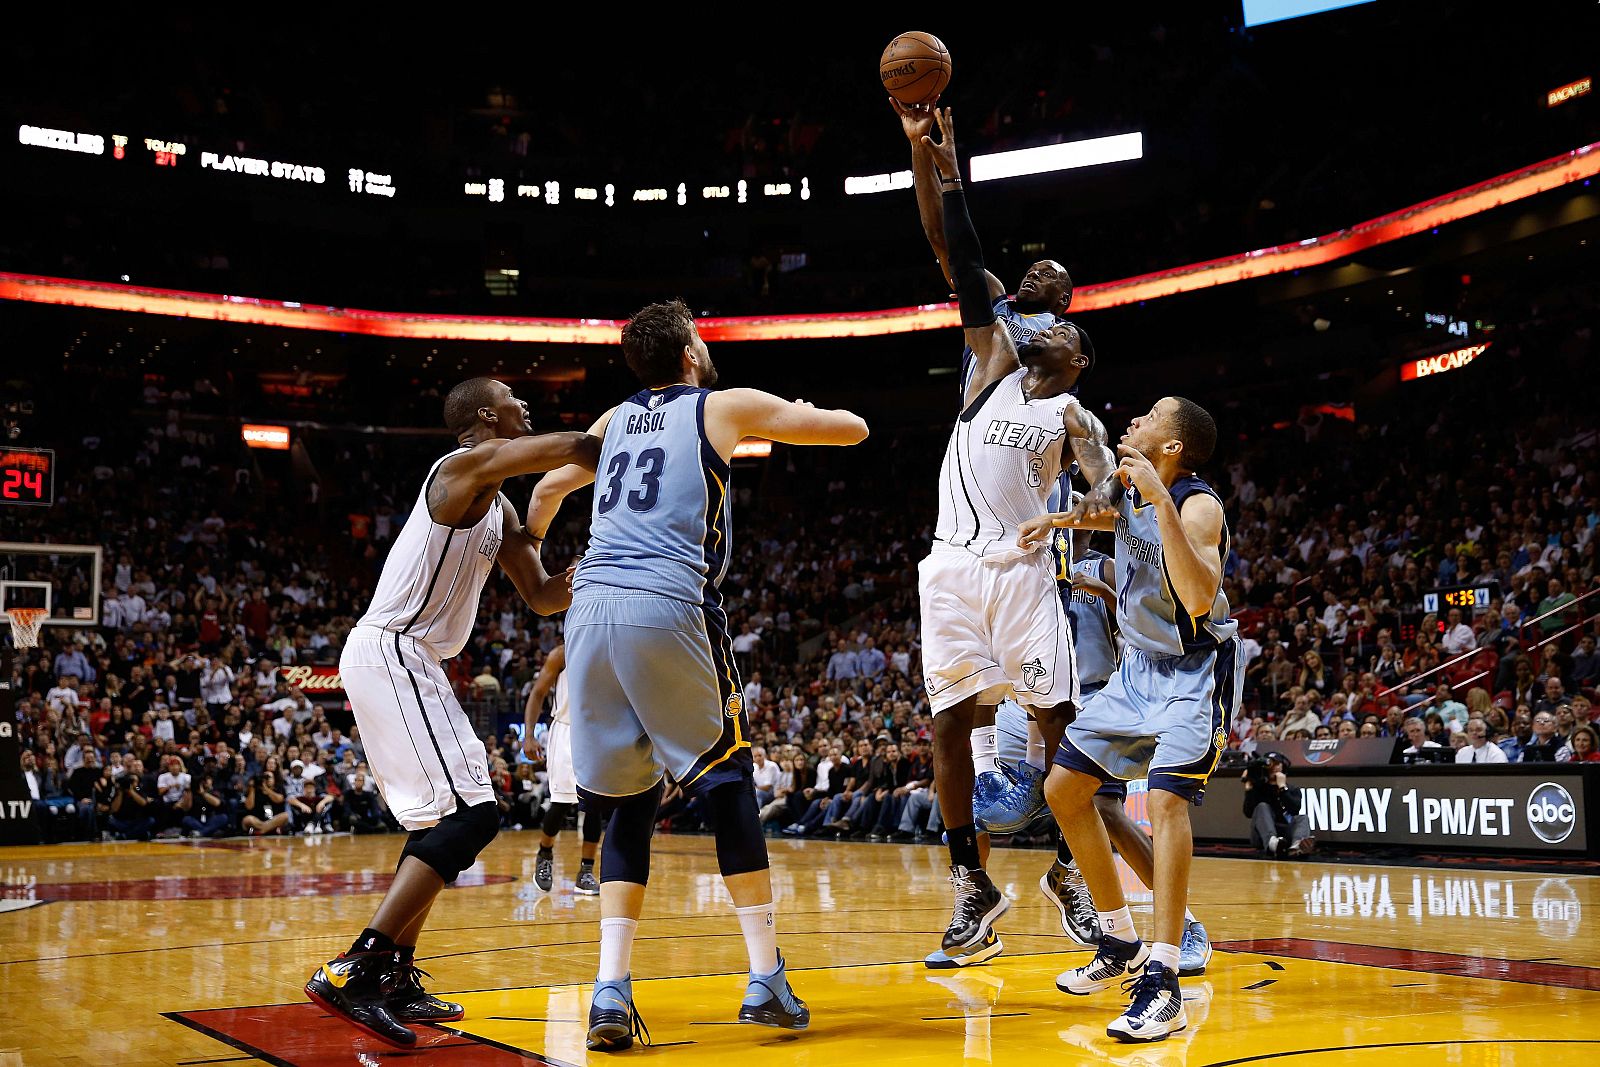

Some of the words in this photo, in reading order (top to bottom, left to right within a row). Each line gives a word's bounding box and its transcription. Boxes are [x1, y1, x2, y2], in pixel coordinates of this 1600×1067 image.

[880, 61, 917, 80] SPALDIN
[201, 152, 269, 176] PLAYER
[271, 161, 325, 184] STATS
[626, 411, 667, 434] GASOL
[984, 420, 1067, 456] HEAT
[3, 469, 42, 499] 24
[598, 447, 667, 515] 33
[1027, 457, 1044, 488] 6
[1445, 589, 1475, 606] 4:35
[277, 665, 344, 689] Bud
[1308, 739, 1339, 750] ESPN
[8, 800, 32, 819] TV
[1299, 788, 1392, 833] NDAY
[1527, 797, 1574, 823] abc
